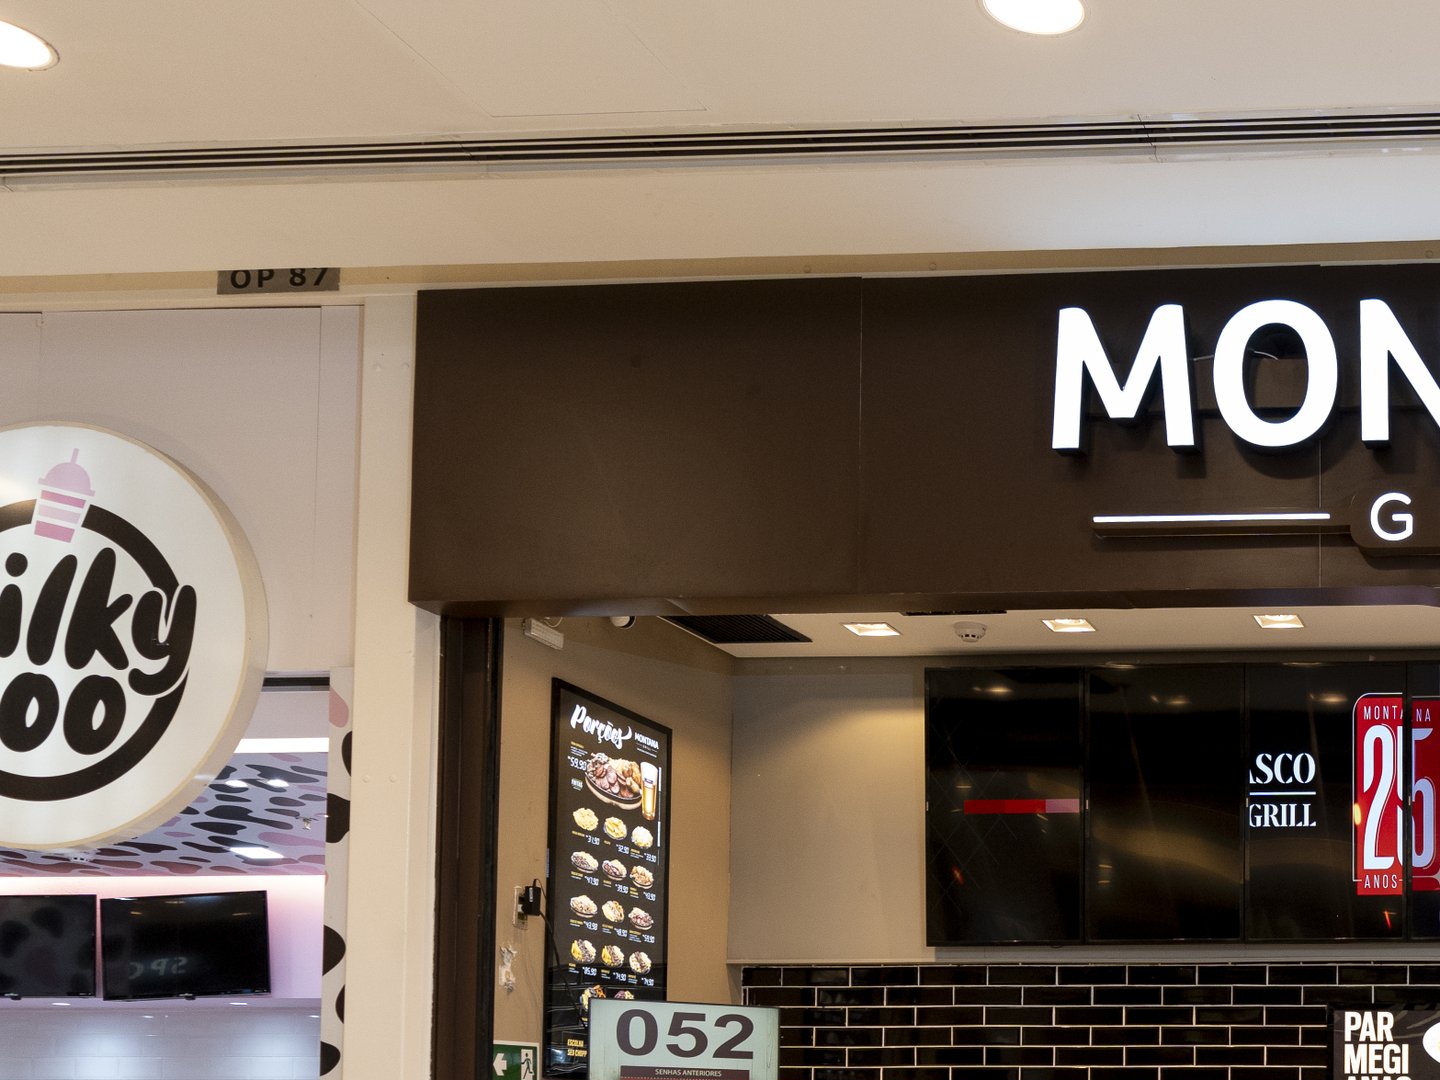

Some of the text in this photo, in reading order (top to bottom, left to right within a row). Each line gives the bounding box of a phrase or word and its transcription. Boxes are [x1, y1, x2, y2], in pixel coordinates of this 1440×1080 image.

[230, 267, 329, 289] OP 87
[570, 704, 632, 750] Porções
[1363, 705, 1431, 722] MONTNA
[634, 732, 659, 750] MONTANA
[1249, 752, 1316, 784] SCO
[1363, 724, 1434, 870] 25
[1249, 803, 1317, 828] GRILL
[1364, 874, 1398, 889] ANOS
[616, 1008, 754, 1060] 052
[1344, 1011, 1394, 1042] PAR
[655, 1068, 682, 1076] SENHAS
[1344, 1043, 1409, 1075] MEGI
